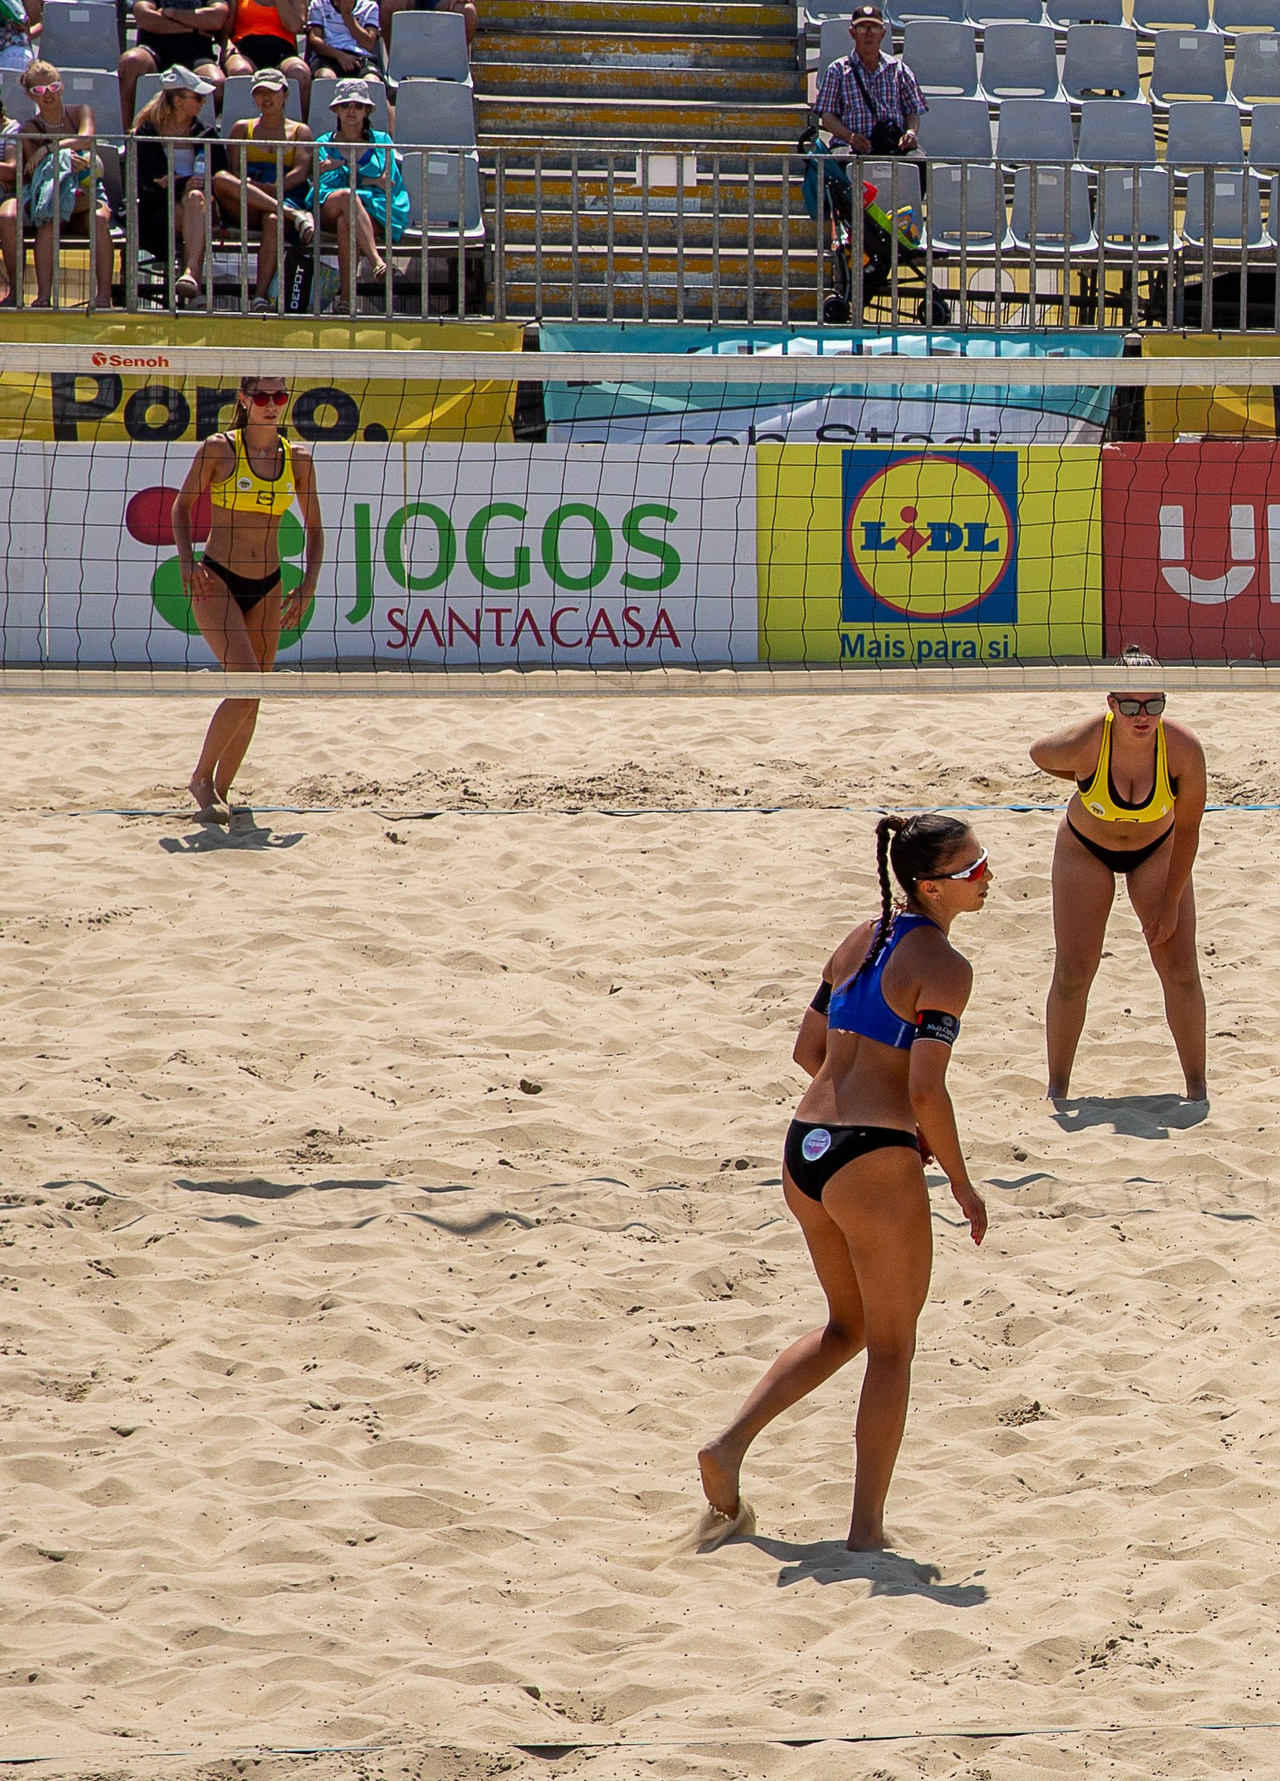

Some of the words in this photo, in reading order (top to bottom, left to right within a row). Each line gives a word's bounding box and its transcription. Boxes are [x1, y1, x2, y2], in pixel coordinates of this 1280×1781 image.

[290, 265, 305, 310] DEPOT
[109, 355, 169, 368] Senoh
[51, 373, 389, 442] Poro.
[346, 502, 682, 624] JOGOS
[840, 633, 905, 659] Mais
[917, 640, 977, 664] para
